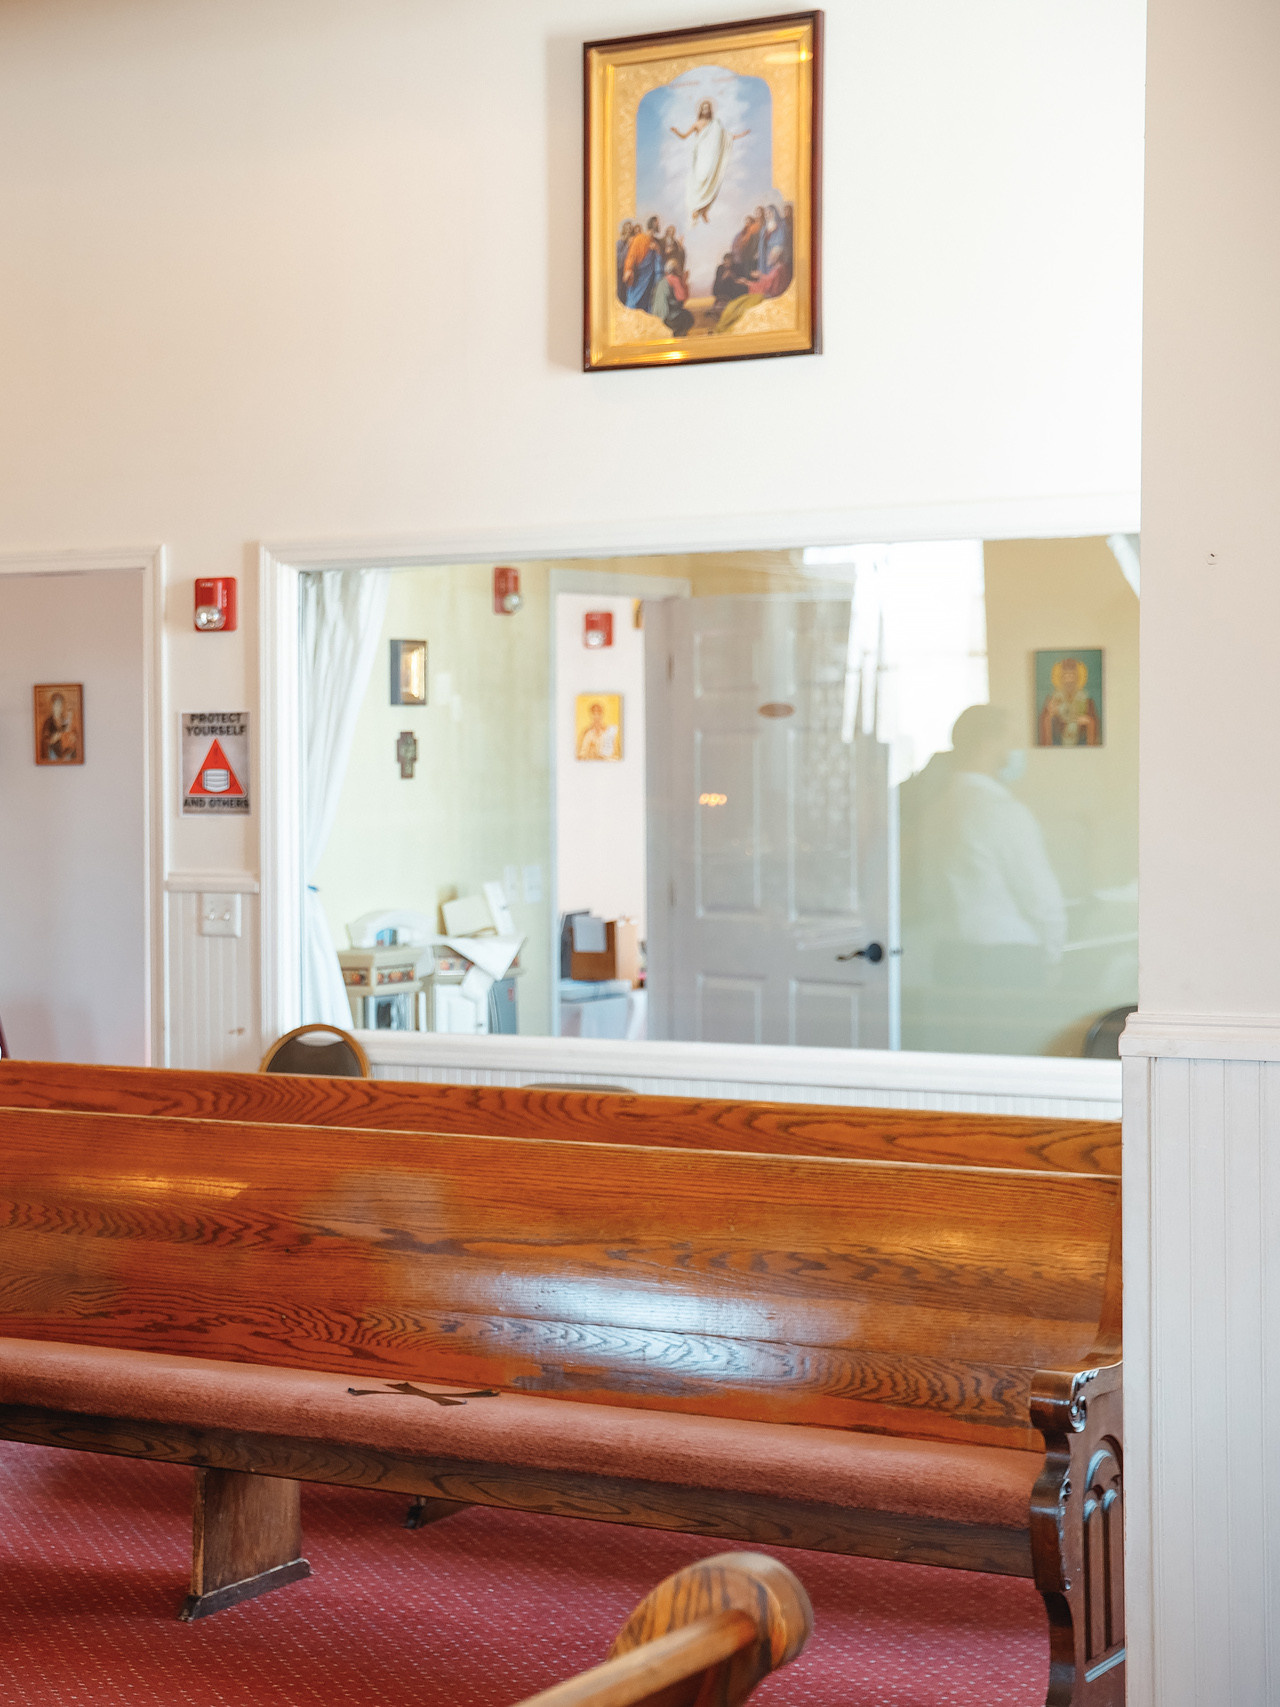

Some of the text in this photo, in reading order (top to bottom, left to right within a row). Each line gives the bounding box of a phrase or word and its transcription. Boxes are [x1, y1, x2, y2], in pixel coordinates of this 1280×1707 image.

[190, 713, 242, 723] PROTECT
[186, 725, 246, 736] YOURSELF
[184, 798, 249, 808] AND OTHERS
